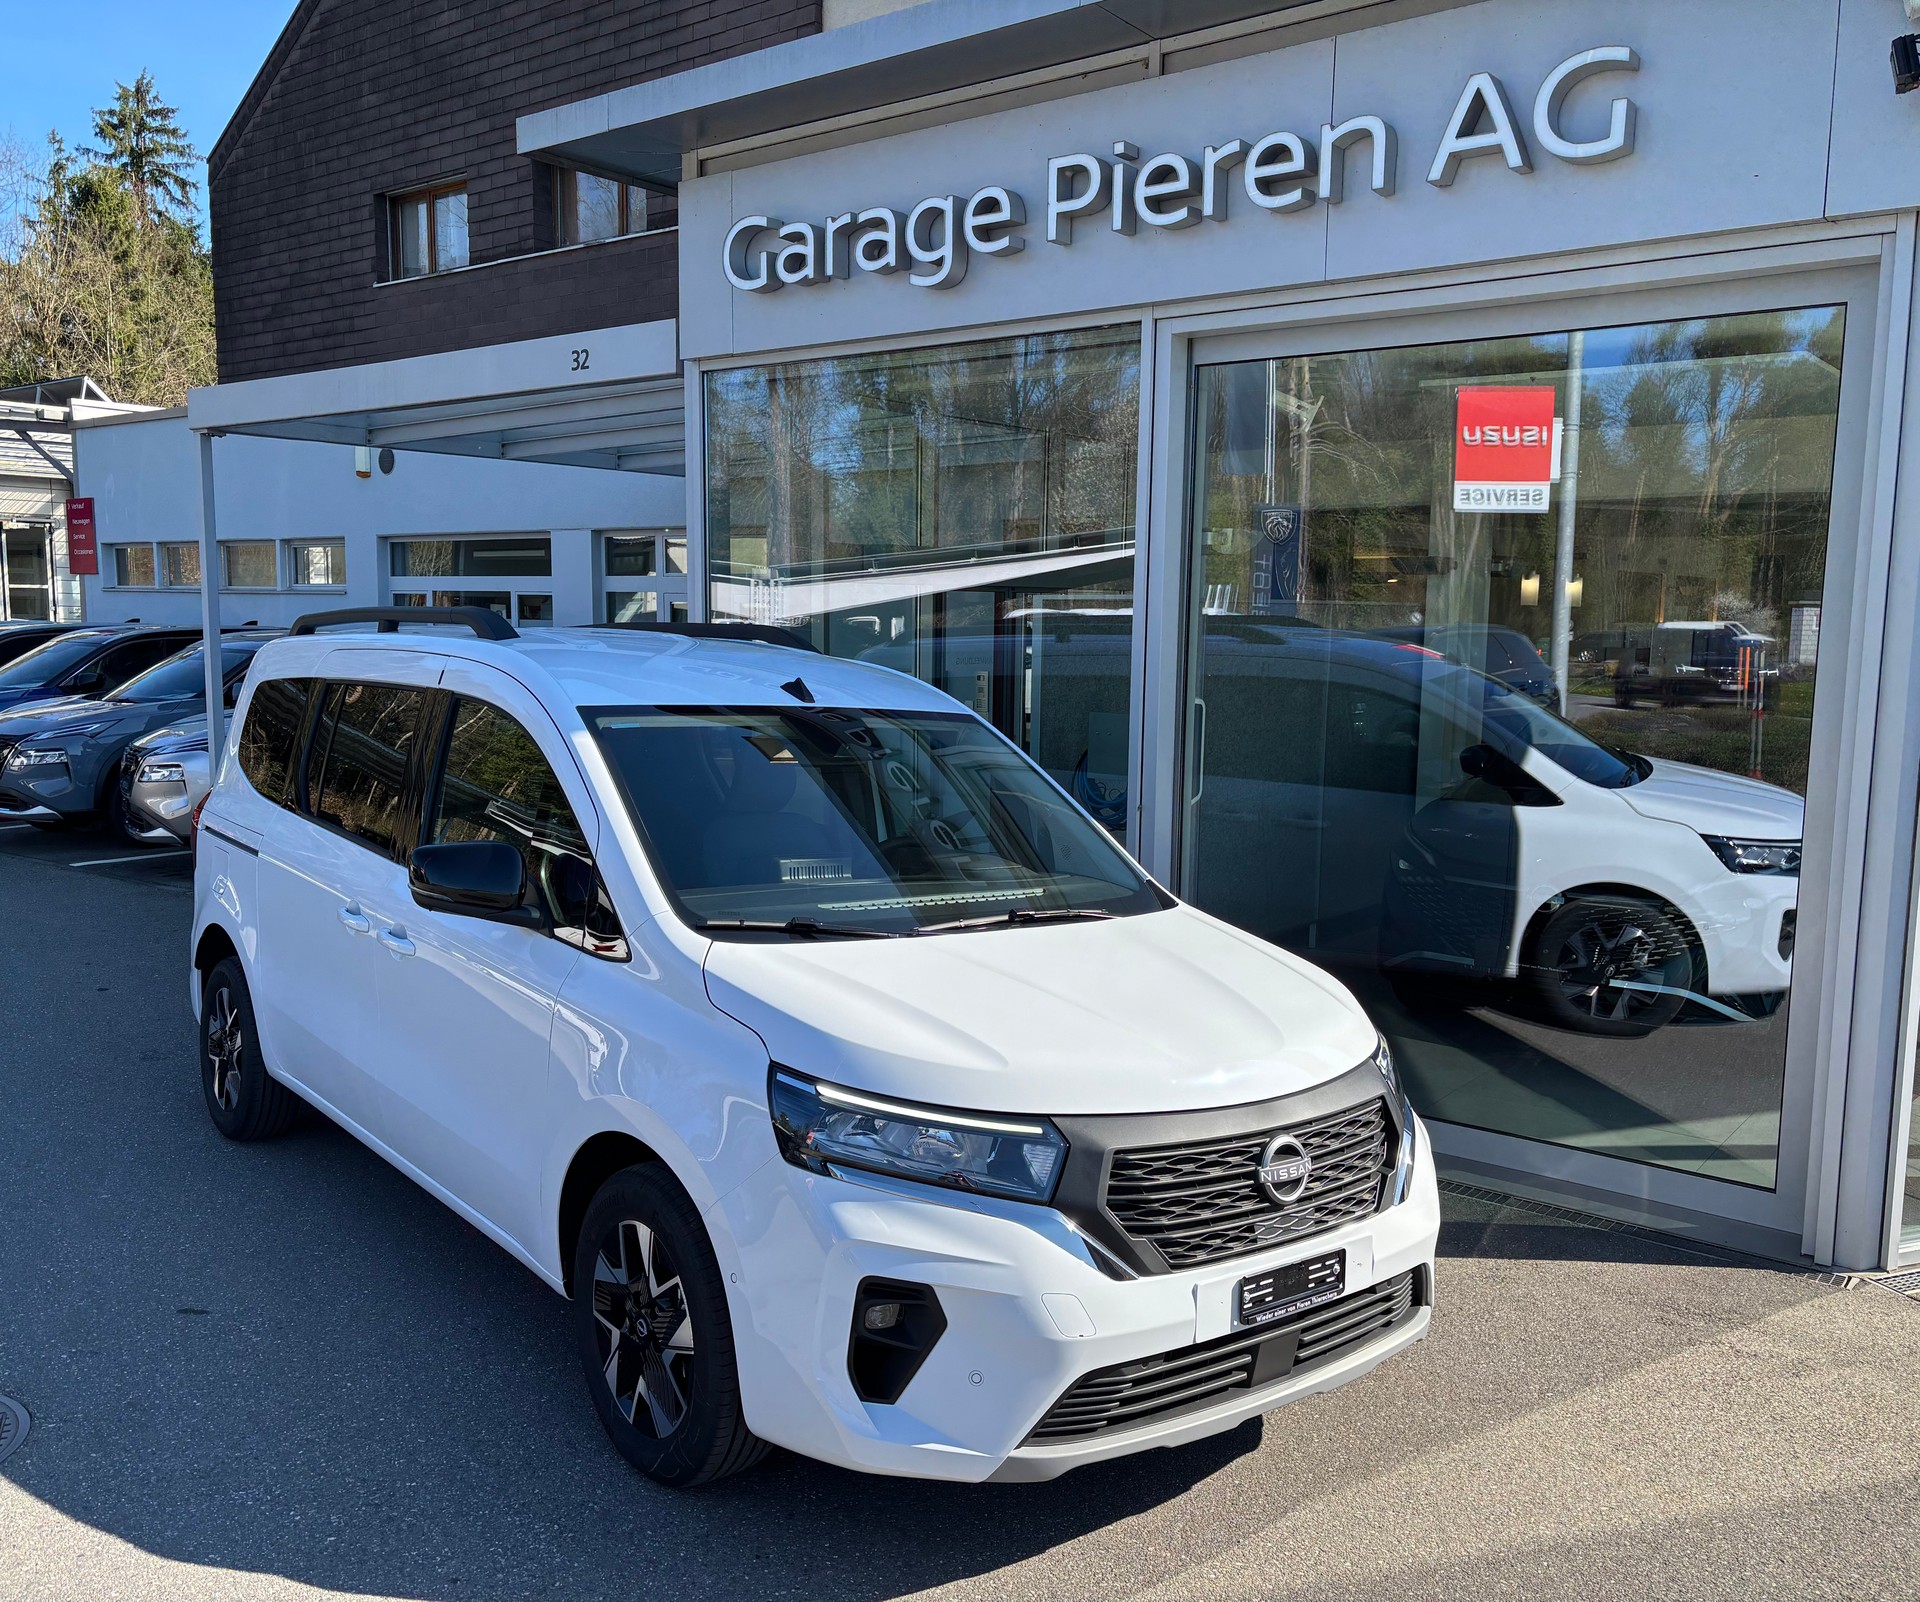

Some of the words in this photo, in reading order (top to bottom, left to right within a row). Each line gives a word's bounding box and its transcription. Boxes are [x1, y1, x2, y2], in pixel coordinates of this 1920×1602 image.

[722, 184, 1025, 292] Garage
[1046, 114, 1397, 246] Pieren
[1426, 45, 1640, 188] AG
[571, 348, 590, 372] 32
[71, 502, 85, 510] Verkauf
[72, 518, 91, 526] Neuwagen
[1260, 1161, 1312, 1182] NISSAN
[1256, 1312, 1274, 1322] Wieder
[1274, 1308, 1287, 1316] einer
[1296, 1300, 1311, 1309] Pieren
